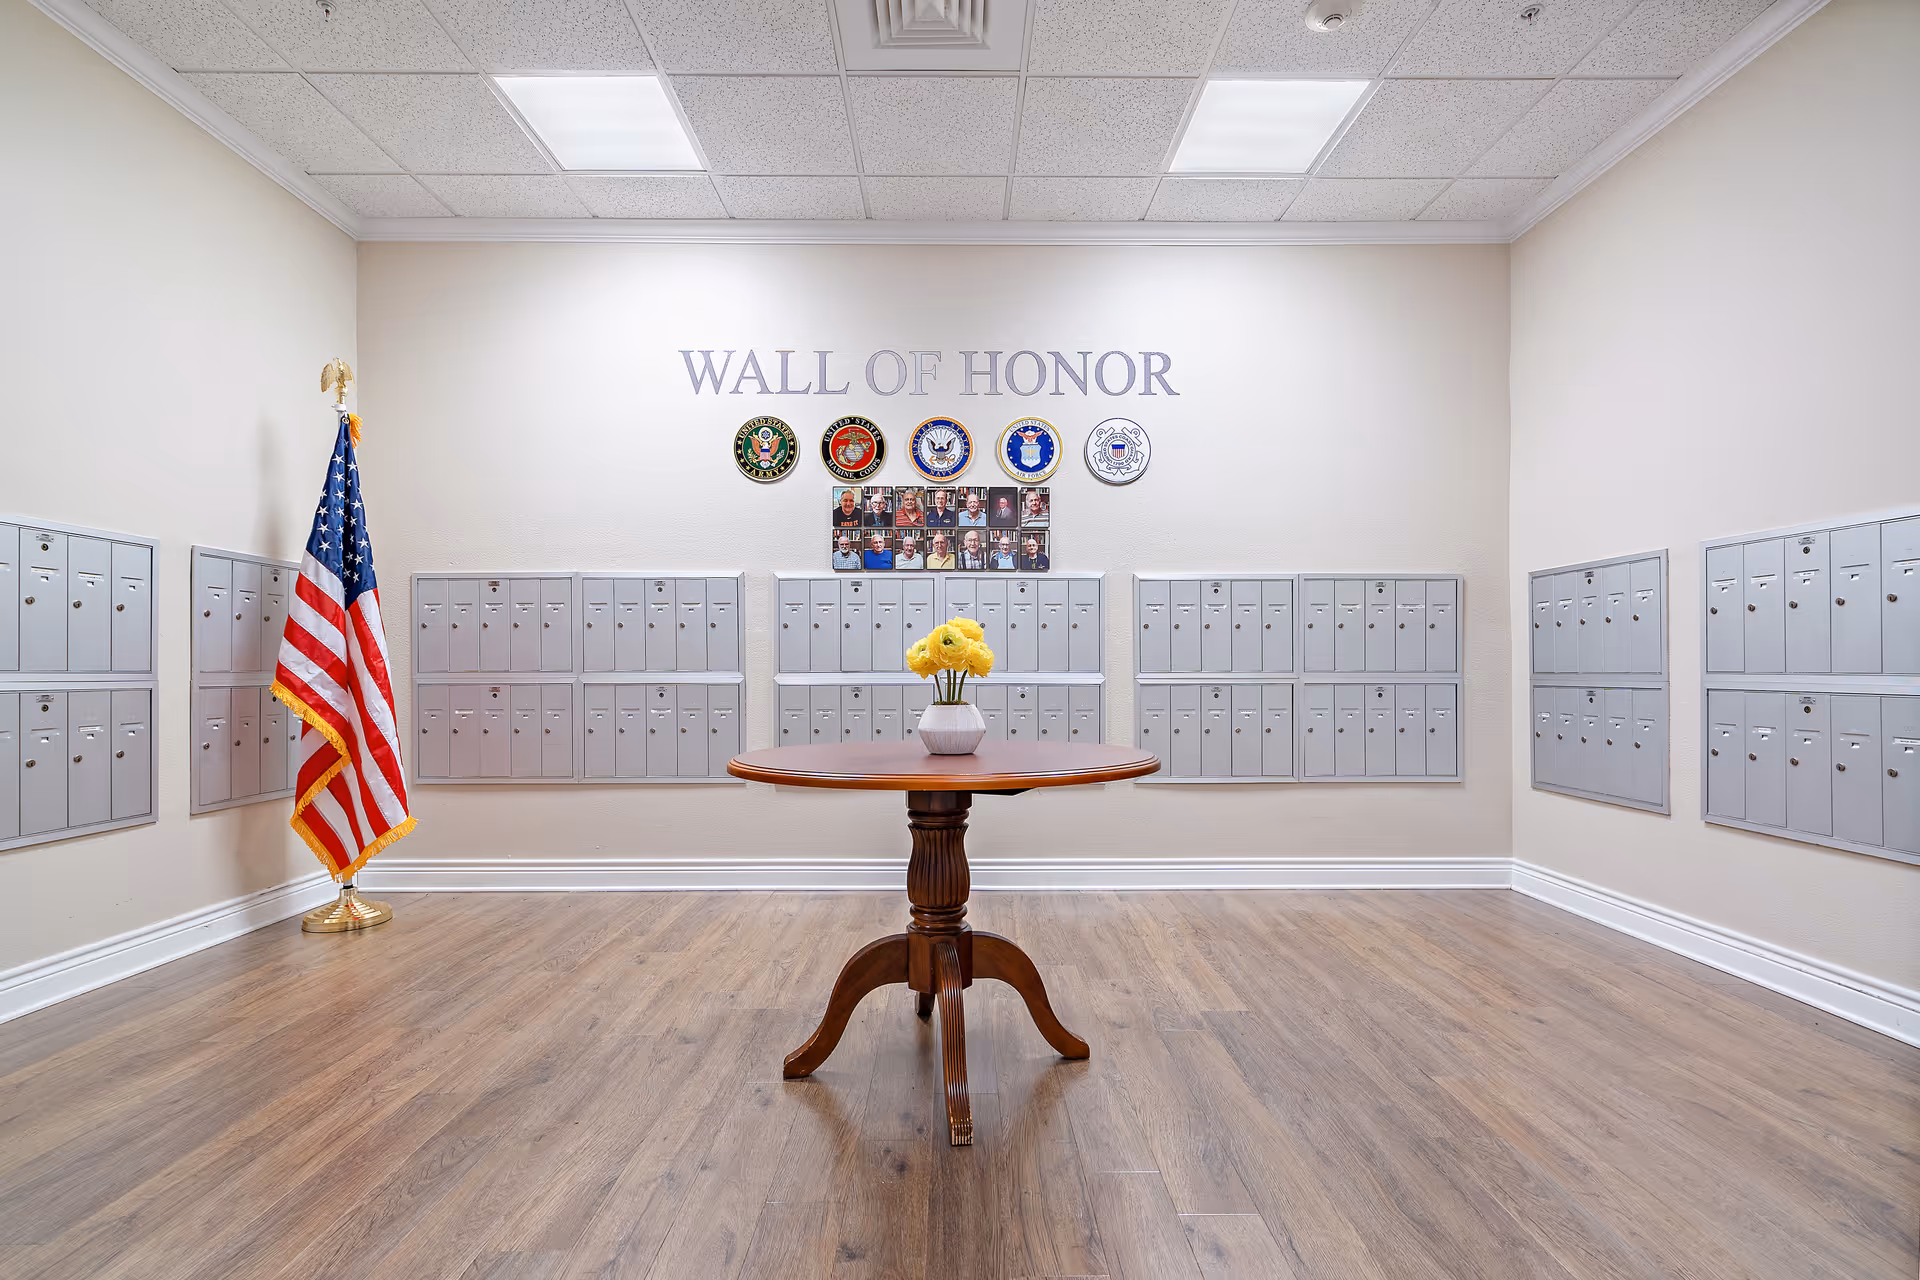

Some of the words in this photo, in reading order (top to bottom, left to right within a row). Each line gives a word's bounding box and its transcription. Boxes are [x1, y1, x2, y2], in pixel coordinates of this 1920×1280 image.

[678, 349, 850, 395] WALL
[865, 349, 942, 396] OF
[958, 350, 1180, 396] HONOR
[739, 418, 766, 439] UNITED
[767, 419, 794, 440] STATES
[824, 418, 850, 442] UNITED
[855, 418, 882, 441] STATES
[1009, 420, 1030, 433] UNITED
[1030, 420, 1051, 432] STATES
[912, 422, 933, 456] UNITED
[951, 423, 969, 456] STATES
[750, 468, 780, 477] ARMY
[827, 459, 855, 478] MARINE
[859, 457, 881, 477] CORPS
[929, 469, 954, 477] NAVY
[1015, 470, 1027, 478] AIR
[1027, 469, 1047, 478] FORCE
